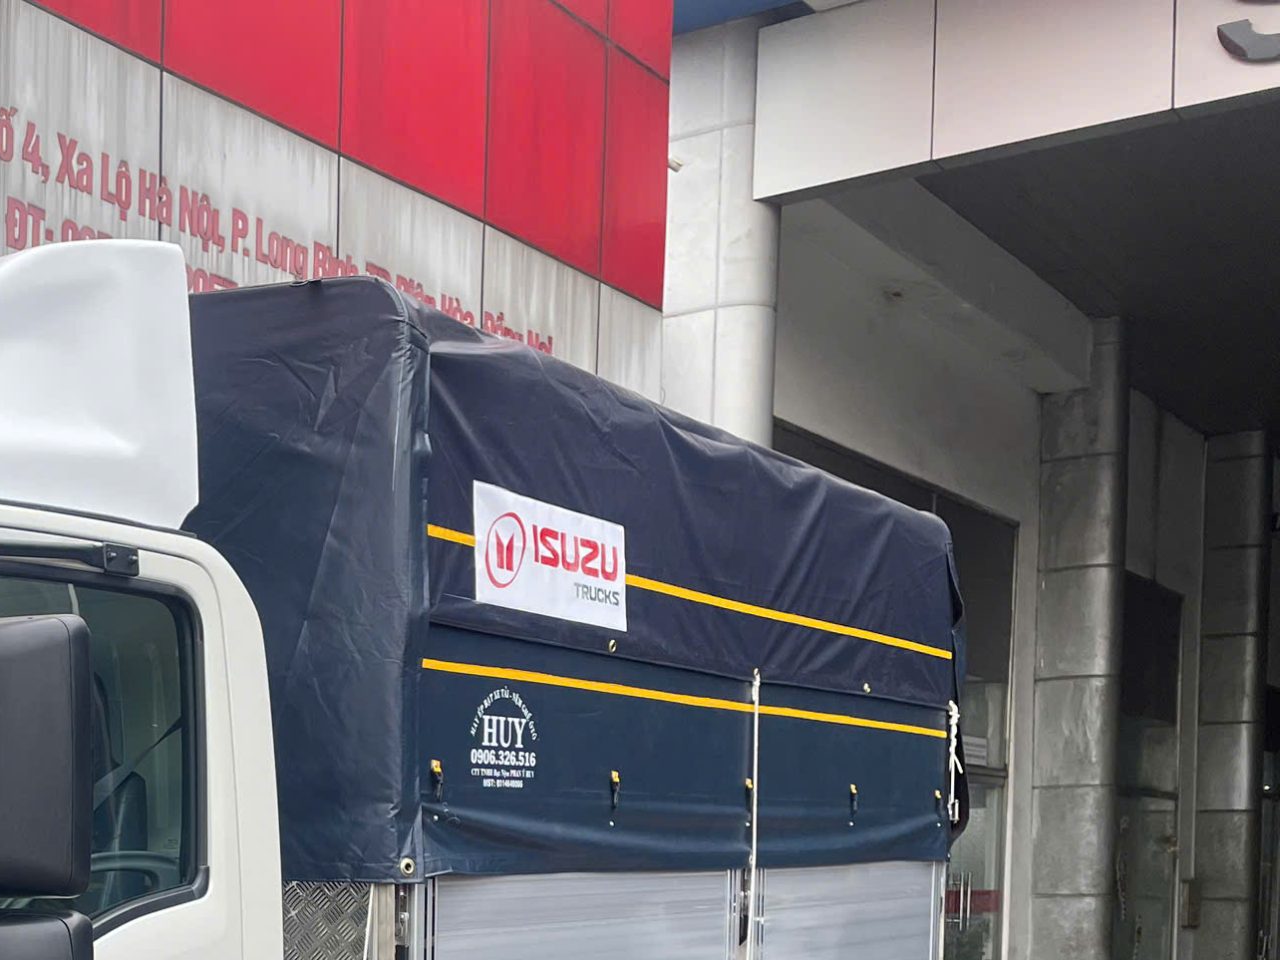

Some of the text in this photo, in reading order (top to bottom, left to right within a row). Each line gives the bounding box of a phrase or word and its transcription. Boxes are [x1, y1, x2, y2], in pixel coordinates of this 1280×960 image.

[22, 121, 50, 183] 4,
[56, 132, 93, 195] Xa
[100, 152, 132, 221] Lộ
[138, 168, 173, 227] Hà
[231, 207, 250, 257] P.
[256, 217, 308, 279] Long
[531, 524, 619, 582] ISUZU
[574, 582, 620, 607] TRUCKS
[482, 715, 527, 749] HUY
[470, 748, 537, 767] 0906.326.516
